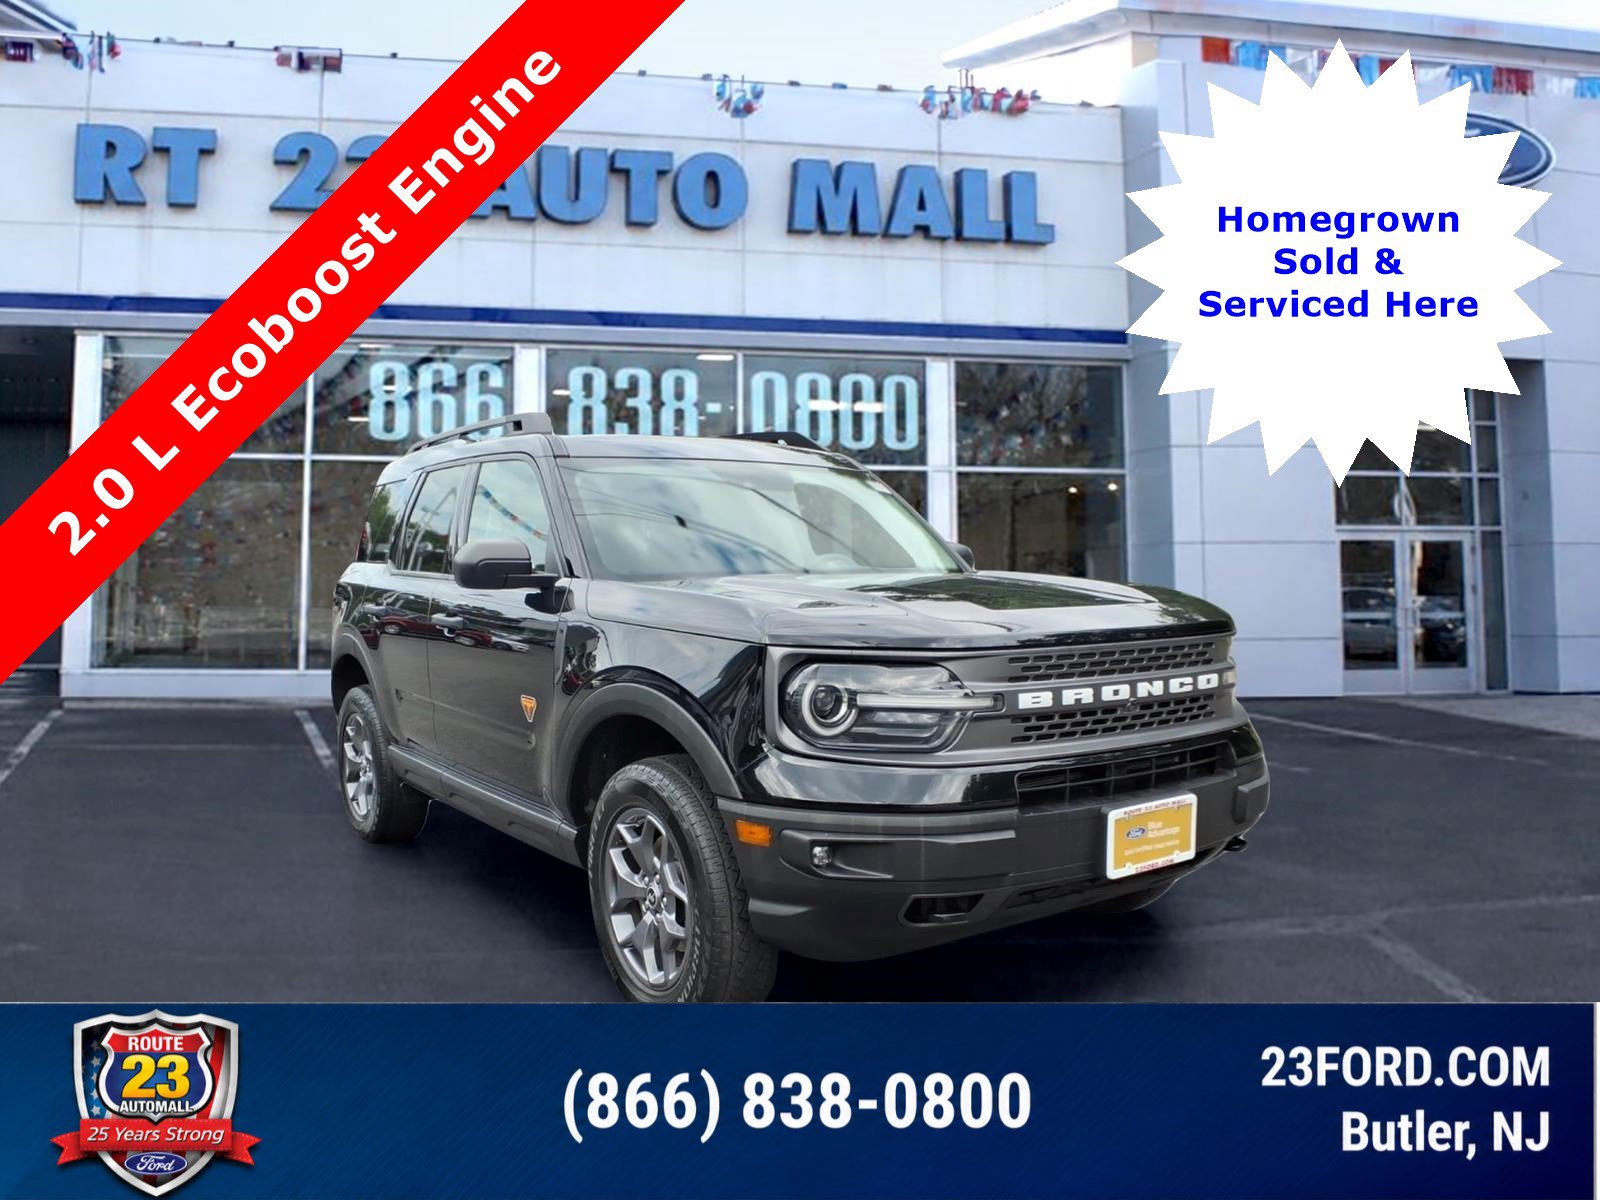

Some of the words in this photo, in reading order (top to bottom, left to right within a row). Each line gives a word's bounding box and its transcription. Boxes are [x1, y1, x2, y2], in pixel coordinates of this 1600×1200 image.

[74, 123, 217, 208] RT
[467, 145, 748, 231] AUTO
[787, 158, 1055, 246] MALL
[369, 361, 503, 441] 866
[1018, 673, 1218, 709] BRONCO
